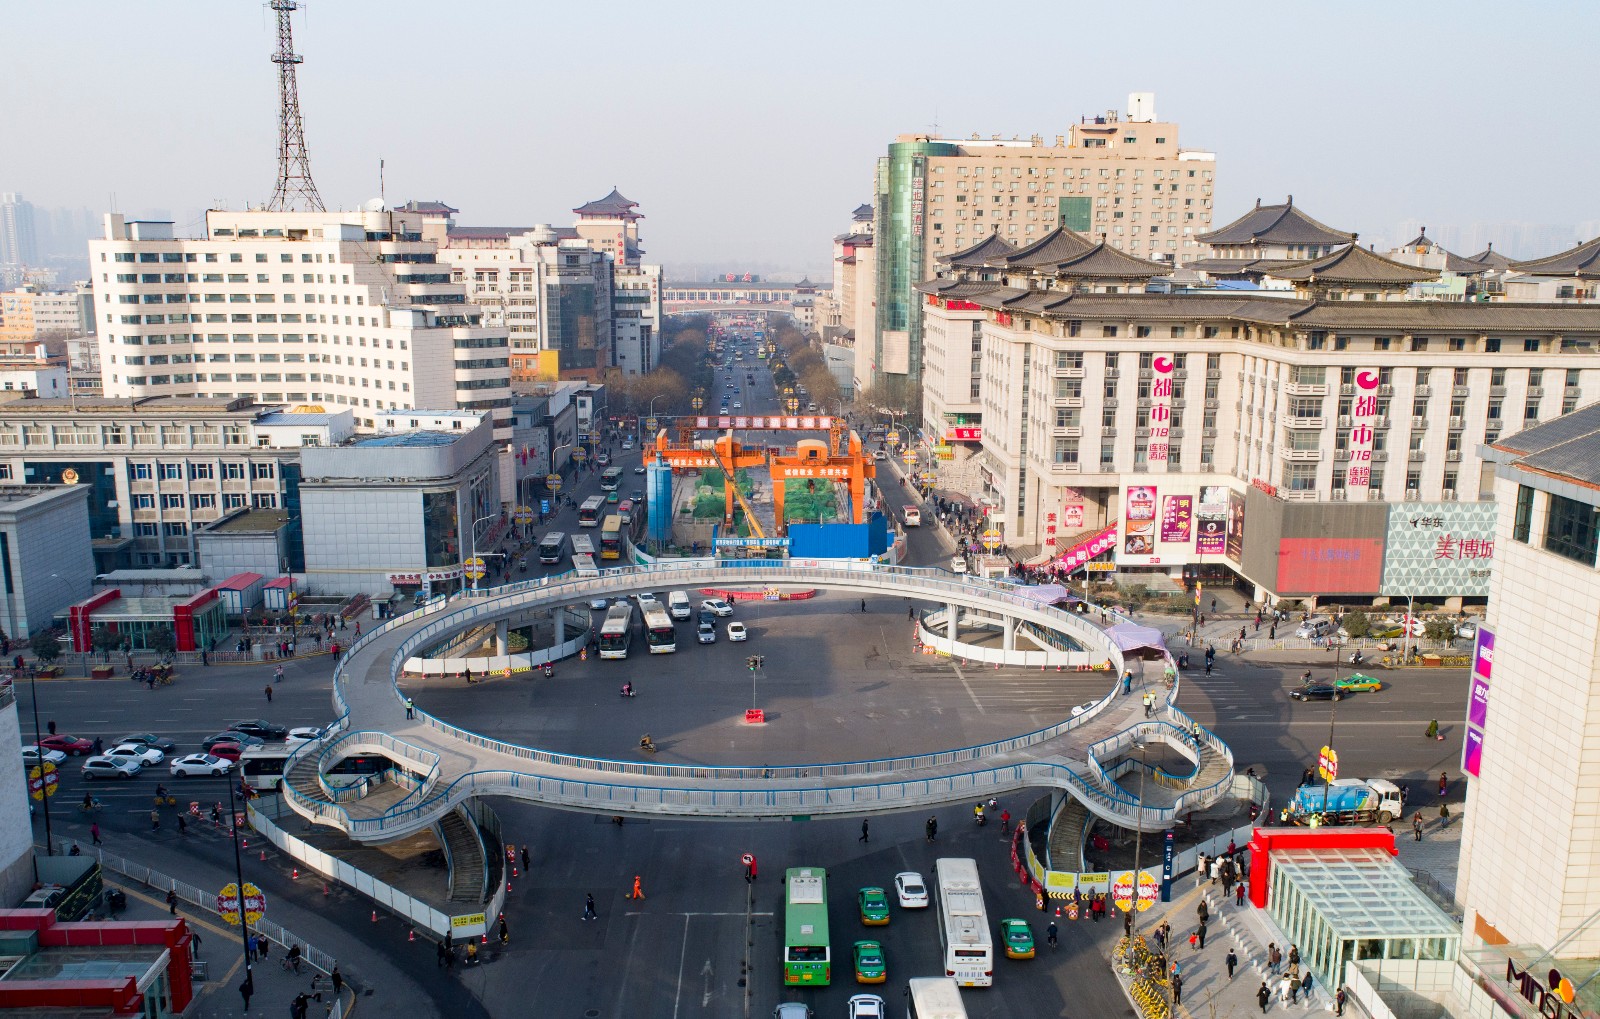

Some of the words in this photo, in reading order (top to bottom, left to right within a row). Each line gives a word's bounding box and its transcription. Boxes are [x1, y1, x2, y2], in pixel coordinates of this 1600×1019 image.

[912, 178, 923, 236] 维也纳酒店
[726, 271, 752, 282] 西安
[1152, 378, 1172, 422] 都市
[1353, 395, 1377, 445] 都市
[1150, 427, 1169, 437] 118
[1149, 443, 1168, 452] 连锁
[1149, 452, 1167, 460] 酒店
[1350, 450, 1371, 460] 118
[1349, 466, 1370, 476] 连锁
[1349, 476, 1369, 485] 酒店
[1421, 517, 1443, 528] 华东
[1045, 512, 1057, 546] 美博城
[1434, 533, 1495, 560] 美博城
